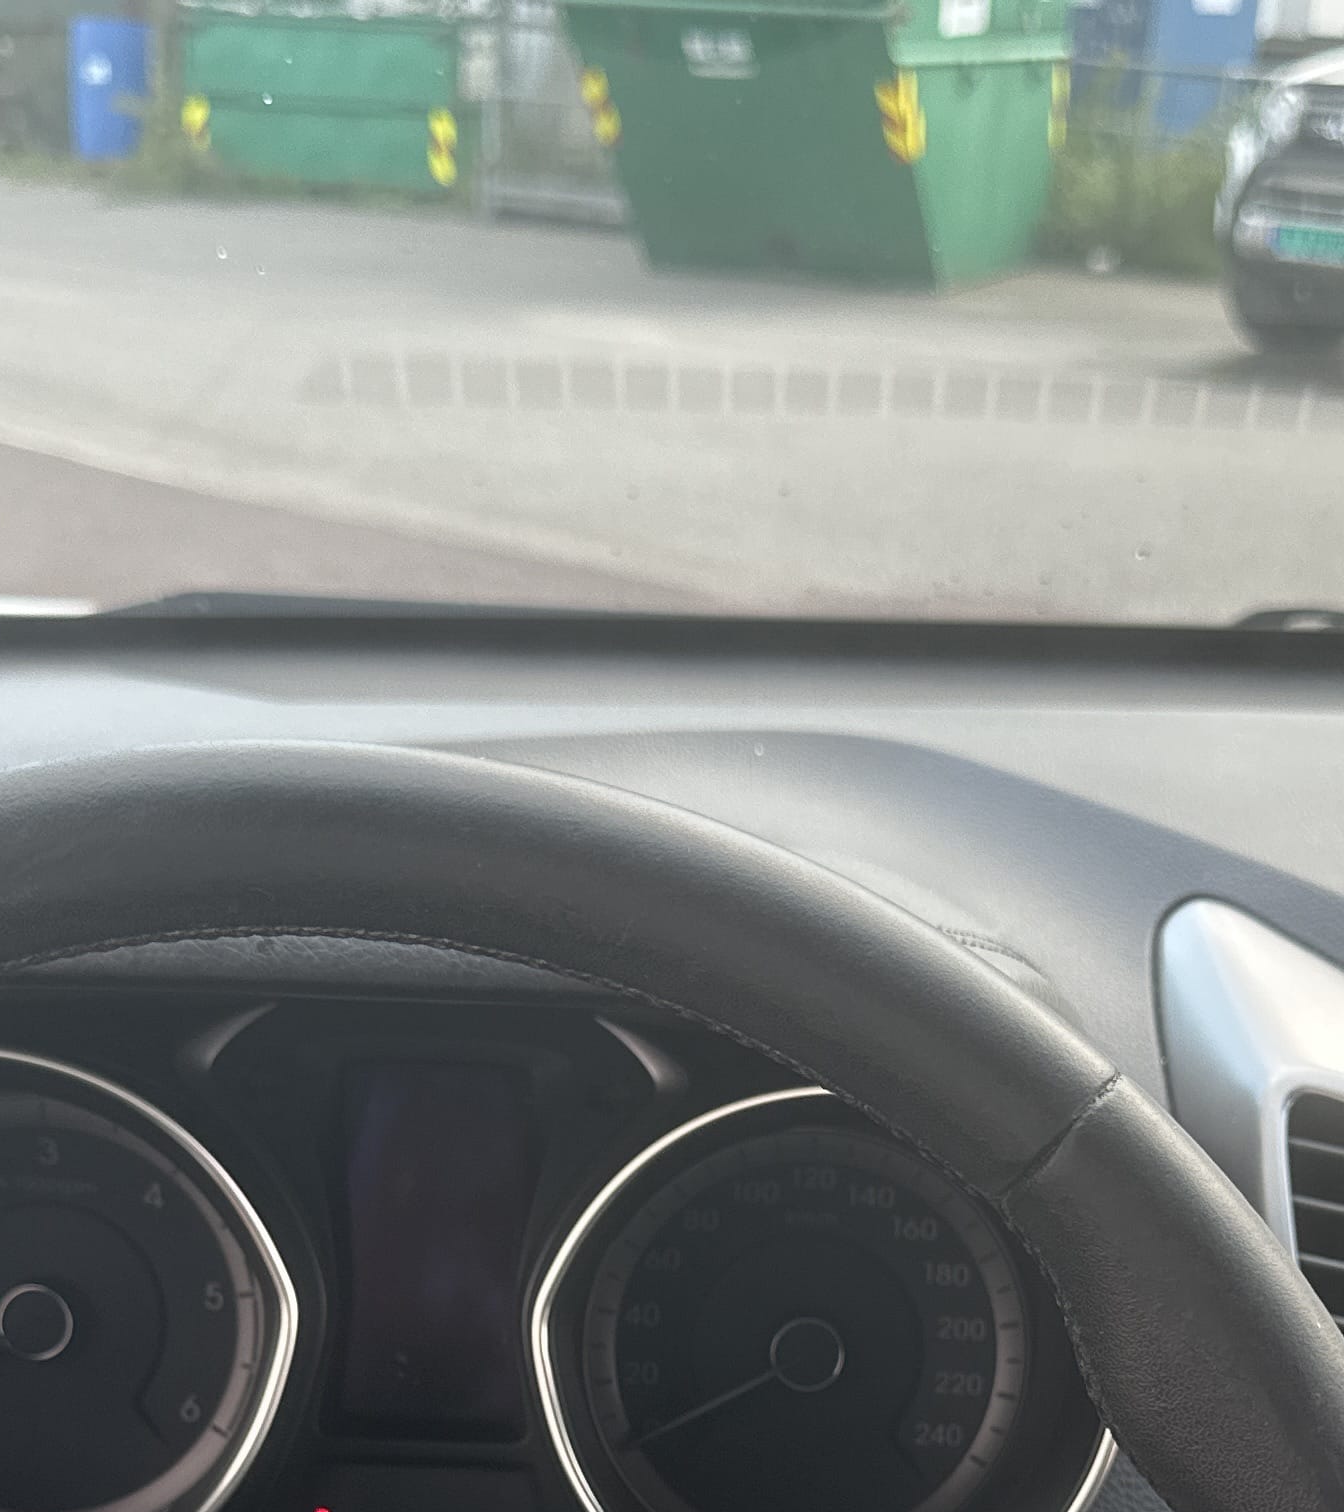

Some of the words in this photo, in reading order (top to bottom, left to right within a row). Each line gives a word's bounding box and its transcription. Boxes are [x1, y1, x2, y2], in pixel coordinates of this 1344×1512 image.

[792, 1167, 837, 1191] 120
[849, 1185, 896, 1208] 140
[891, 1216, 938, 1242] 160
[923, 1262, 970, 1288] 180
[936, 1318, 987, 1342] 200
[934, 1372, 984, 1397] 220
[913, 1424, 963, 1449] 240
